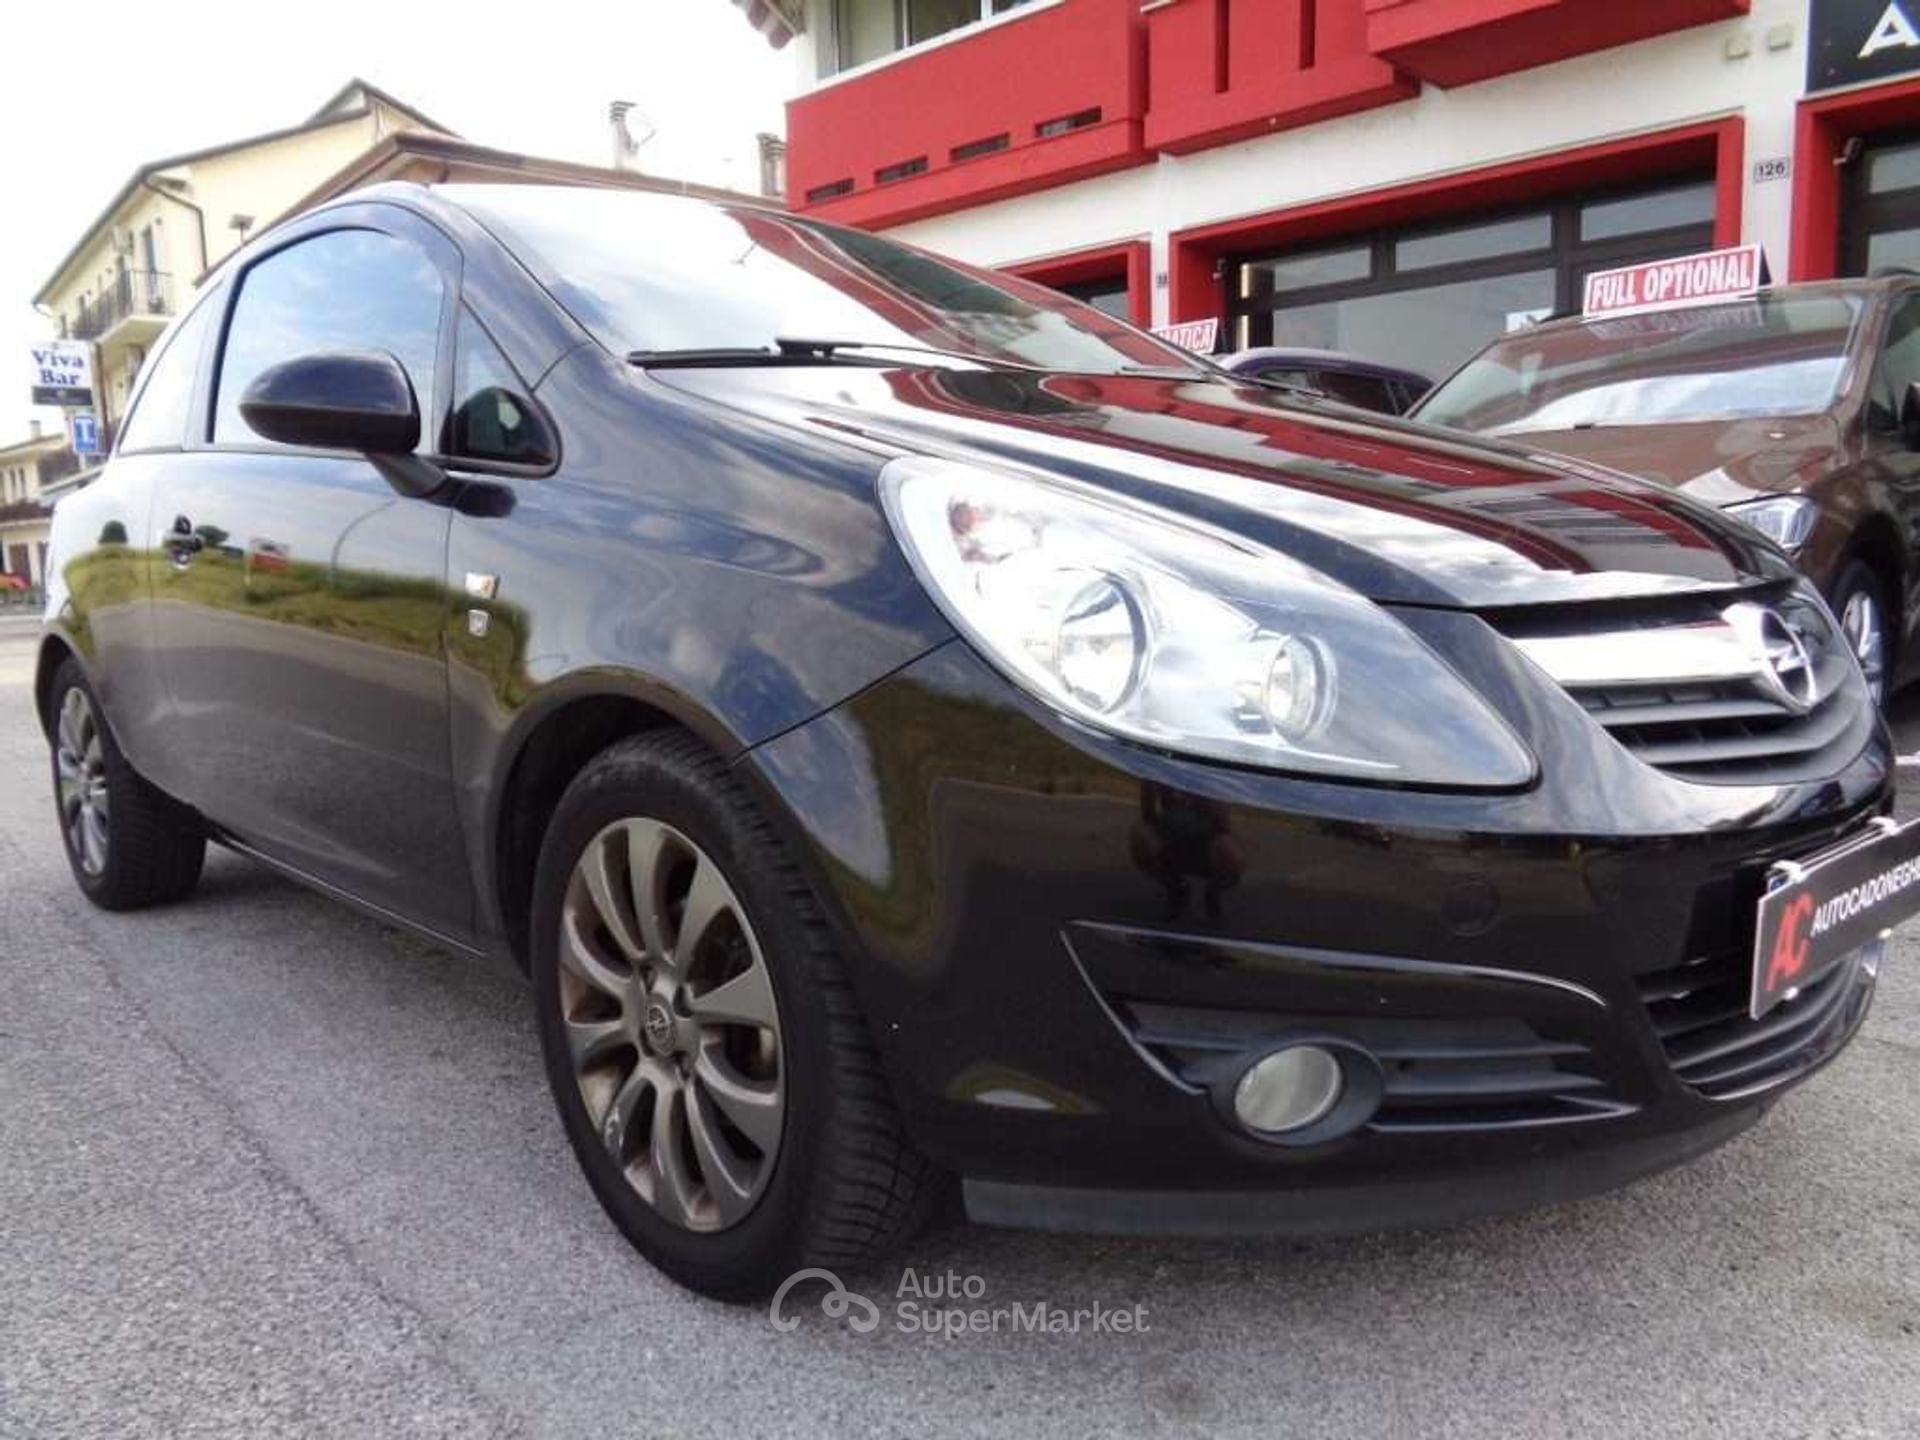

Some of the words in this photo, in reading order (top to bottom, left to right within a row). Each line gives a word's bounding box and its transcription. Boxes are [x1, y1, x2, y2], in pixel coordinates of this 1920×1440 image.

[1757, 162, 1786, 178] 126
[1591, 272, 1637, 310] FULL
[1643, 252, 1751, 301] OPTIONAL
[32, 350, 84, 367] Viva
[41, 369, 80, 386] Bar
